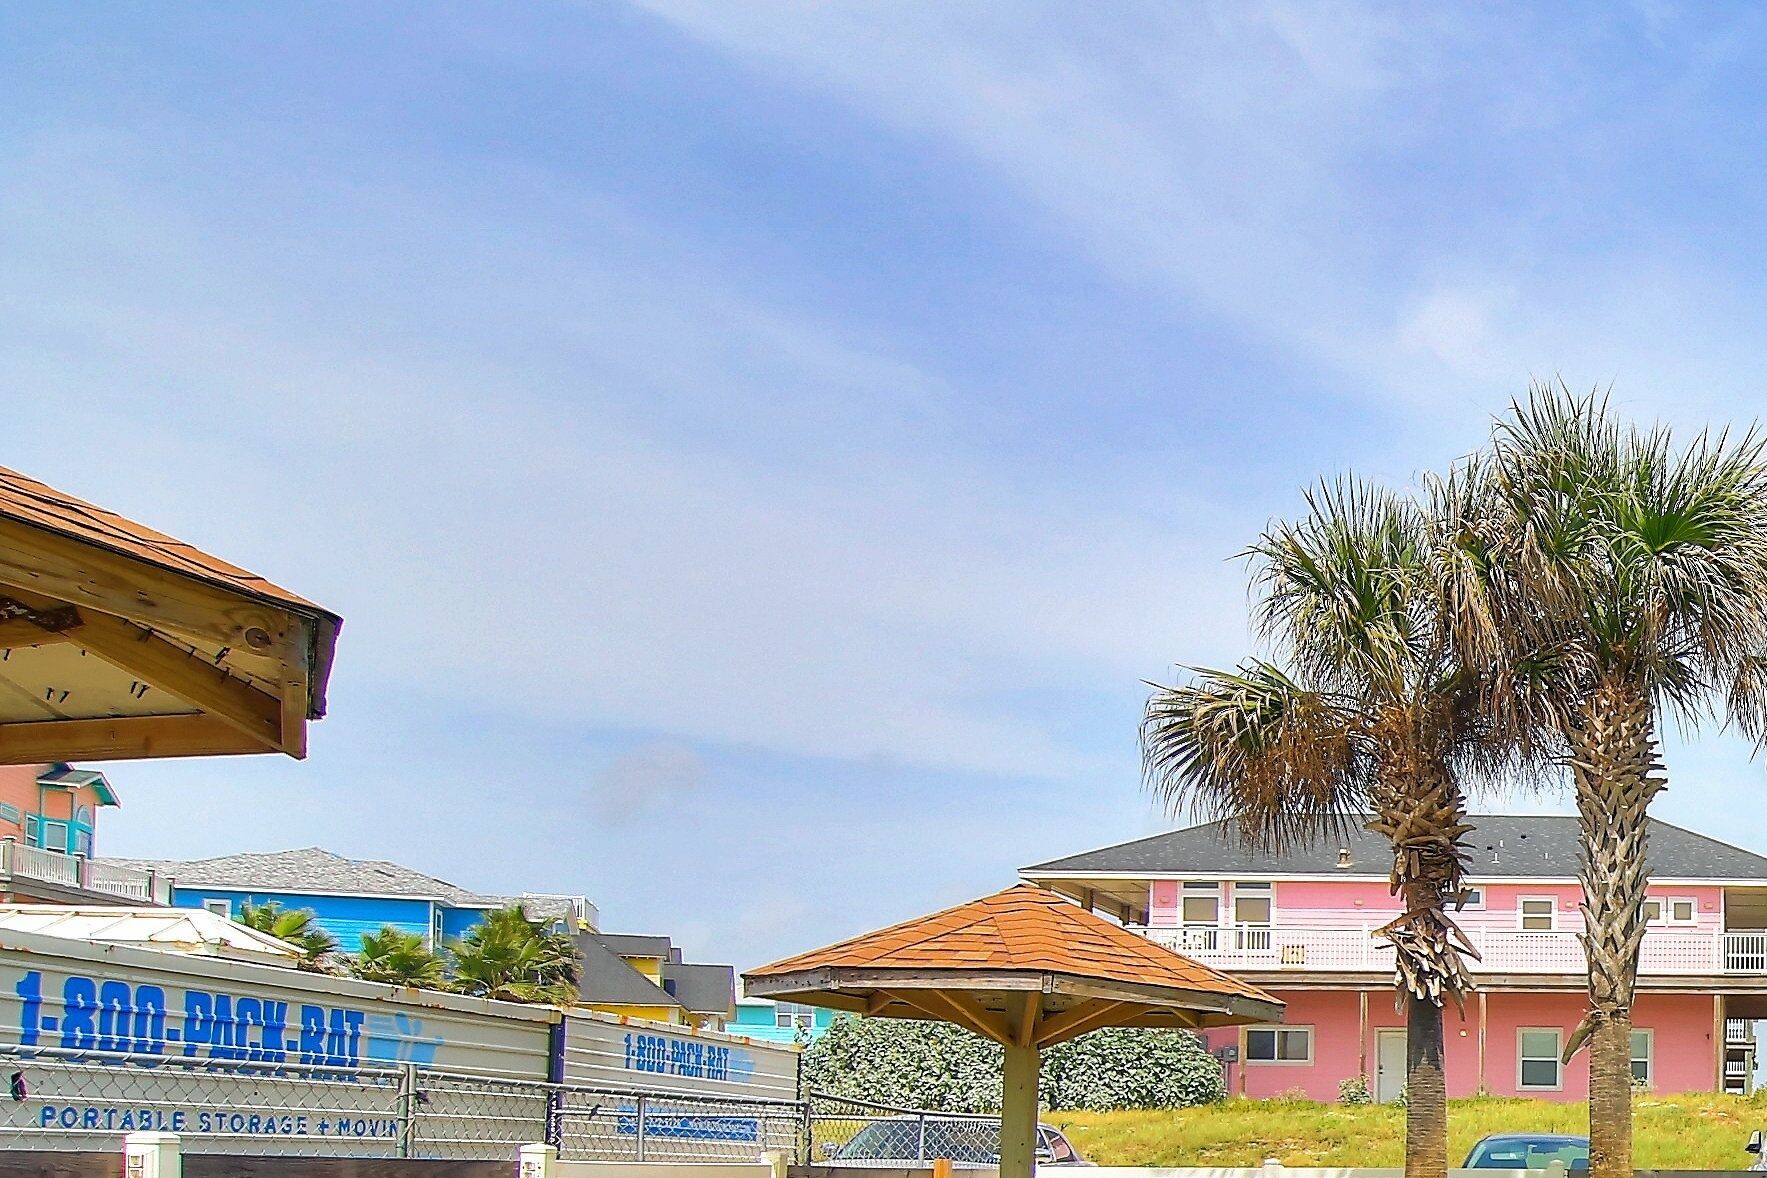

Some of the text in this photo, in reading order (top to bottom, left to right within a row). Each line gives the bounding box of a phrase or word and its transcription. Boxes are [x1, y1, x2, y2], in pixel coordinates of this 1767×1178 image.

[16, 970, 365, 1083] 1-800-PACK-RAT
[624, 1033, 730, 1080] 1-800-PACK-RAT
[41, 1105, 185, 1132] PORTABLE
[200, 1112, 307, 1135] STORAGE
[338, 1117, 398, 1137] MOVIN
